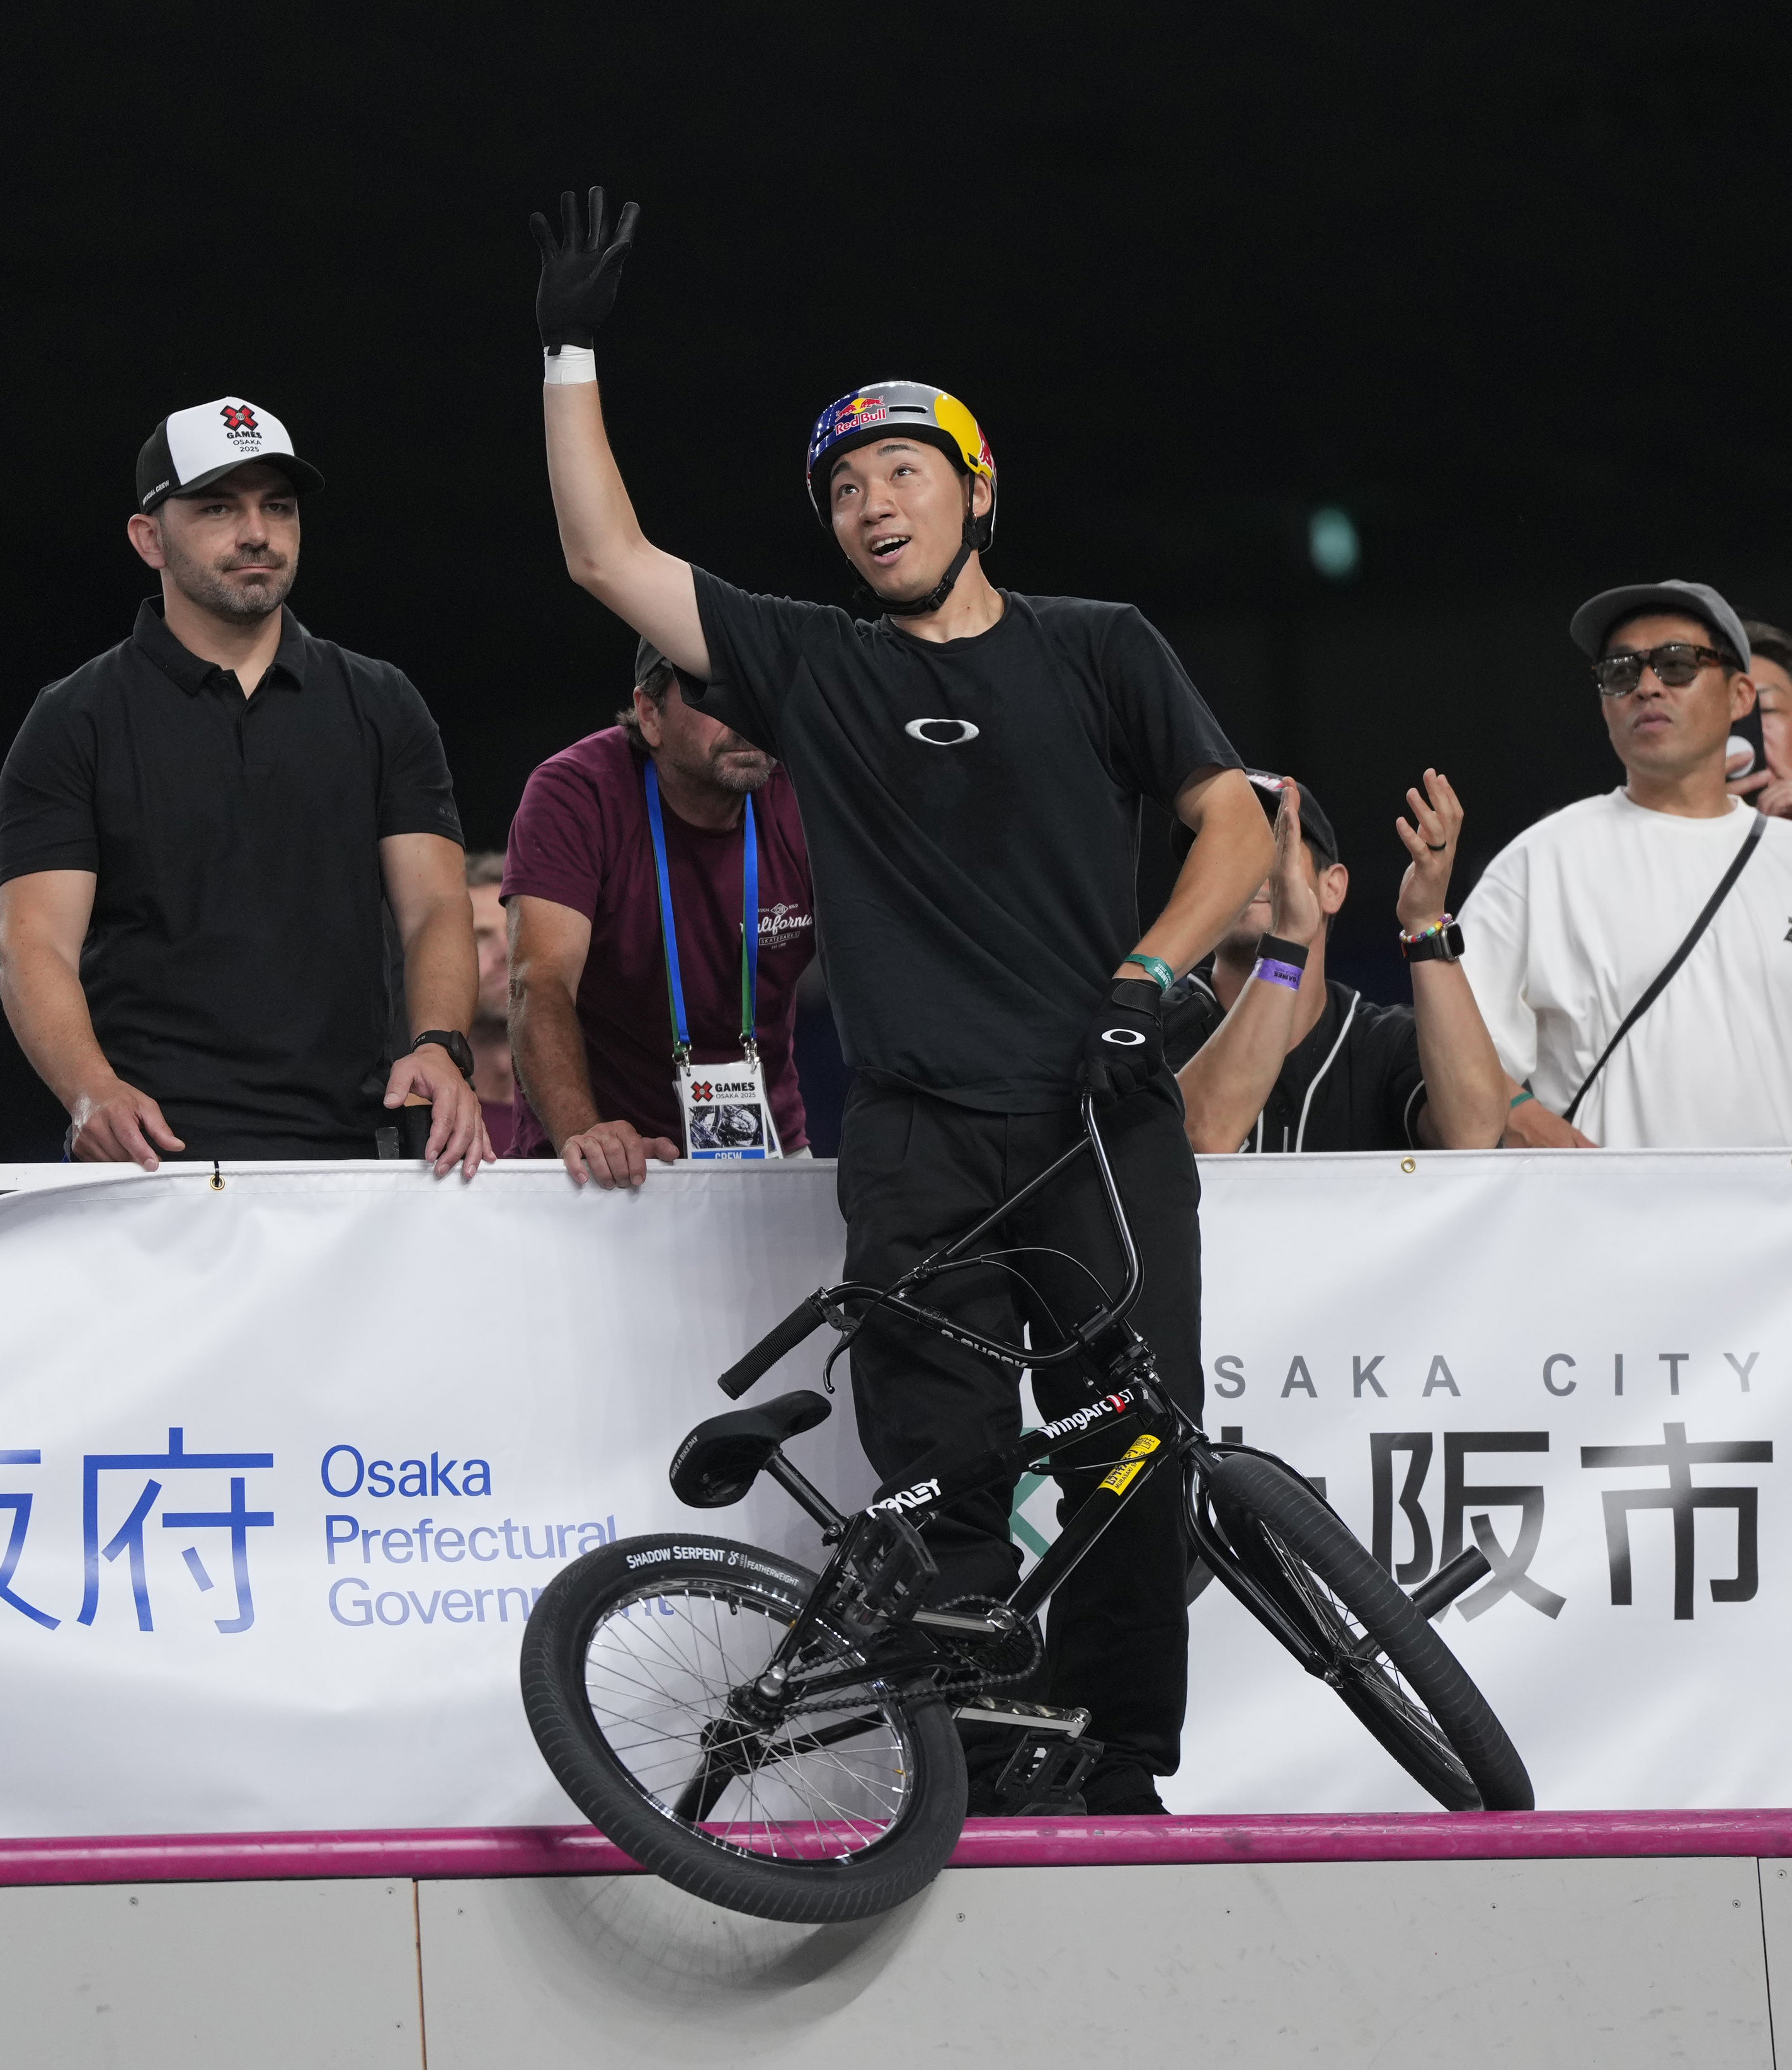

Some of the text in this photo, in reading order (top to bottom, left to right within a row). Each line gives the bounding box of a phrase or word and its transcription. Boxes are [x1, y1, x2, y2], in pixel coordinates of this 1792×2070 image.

[835, 409, 886, 436] Red Bull
[226, 431, 262, 440] GAMES
[156, 479, 169, 494] CREW
[761, 933, 799, 944] SKATEPARKS
[1274, 970, 1297, 982] GAMES
[715, 1082, 755, 1093] GAMES
[1214, 1351, 1761, 1399] SAKA CITY
[687, 1435, 699, 1448] DAY
[1141, 1437, 1155, 1449] LIFE
[321, 1444, 491, 1498] Osaka
[1114, 1466, 1134, 1489] MURASAKI
[1187, 1421, 1774, 1623] 阪市
[328, 1515, 617, 1565] Prefectural
[626, 1547, 671, 1569] SHADOW
[673, 1545, 726, 1563] SERPENT
[746, 1560, 800, 1586] FEATHERWEIGHT
